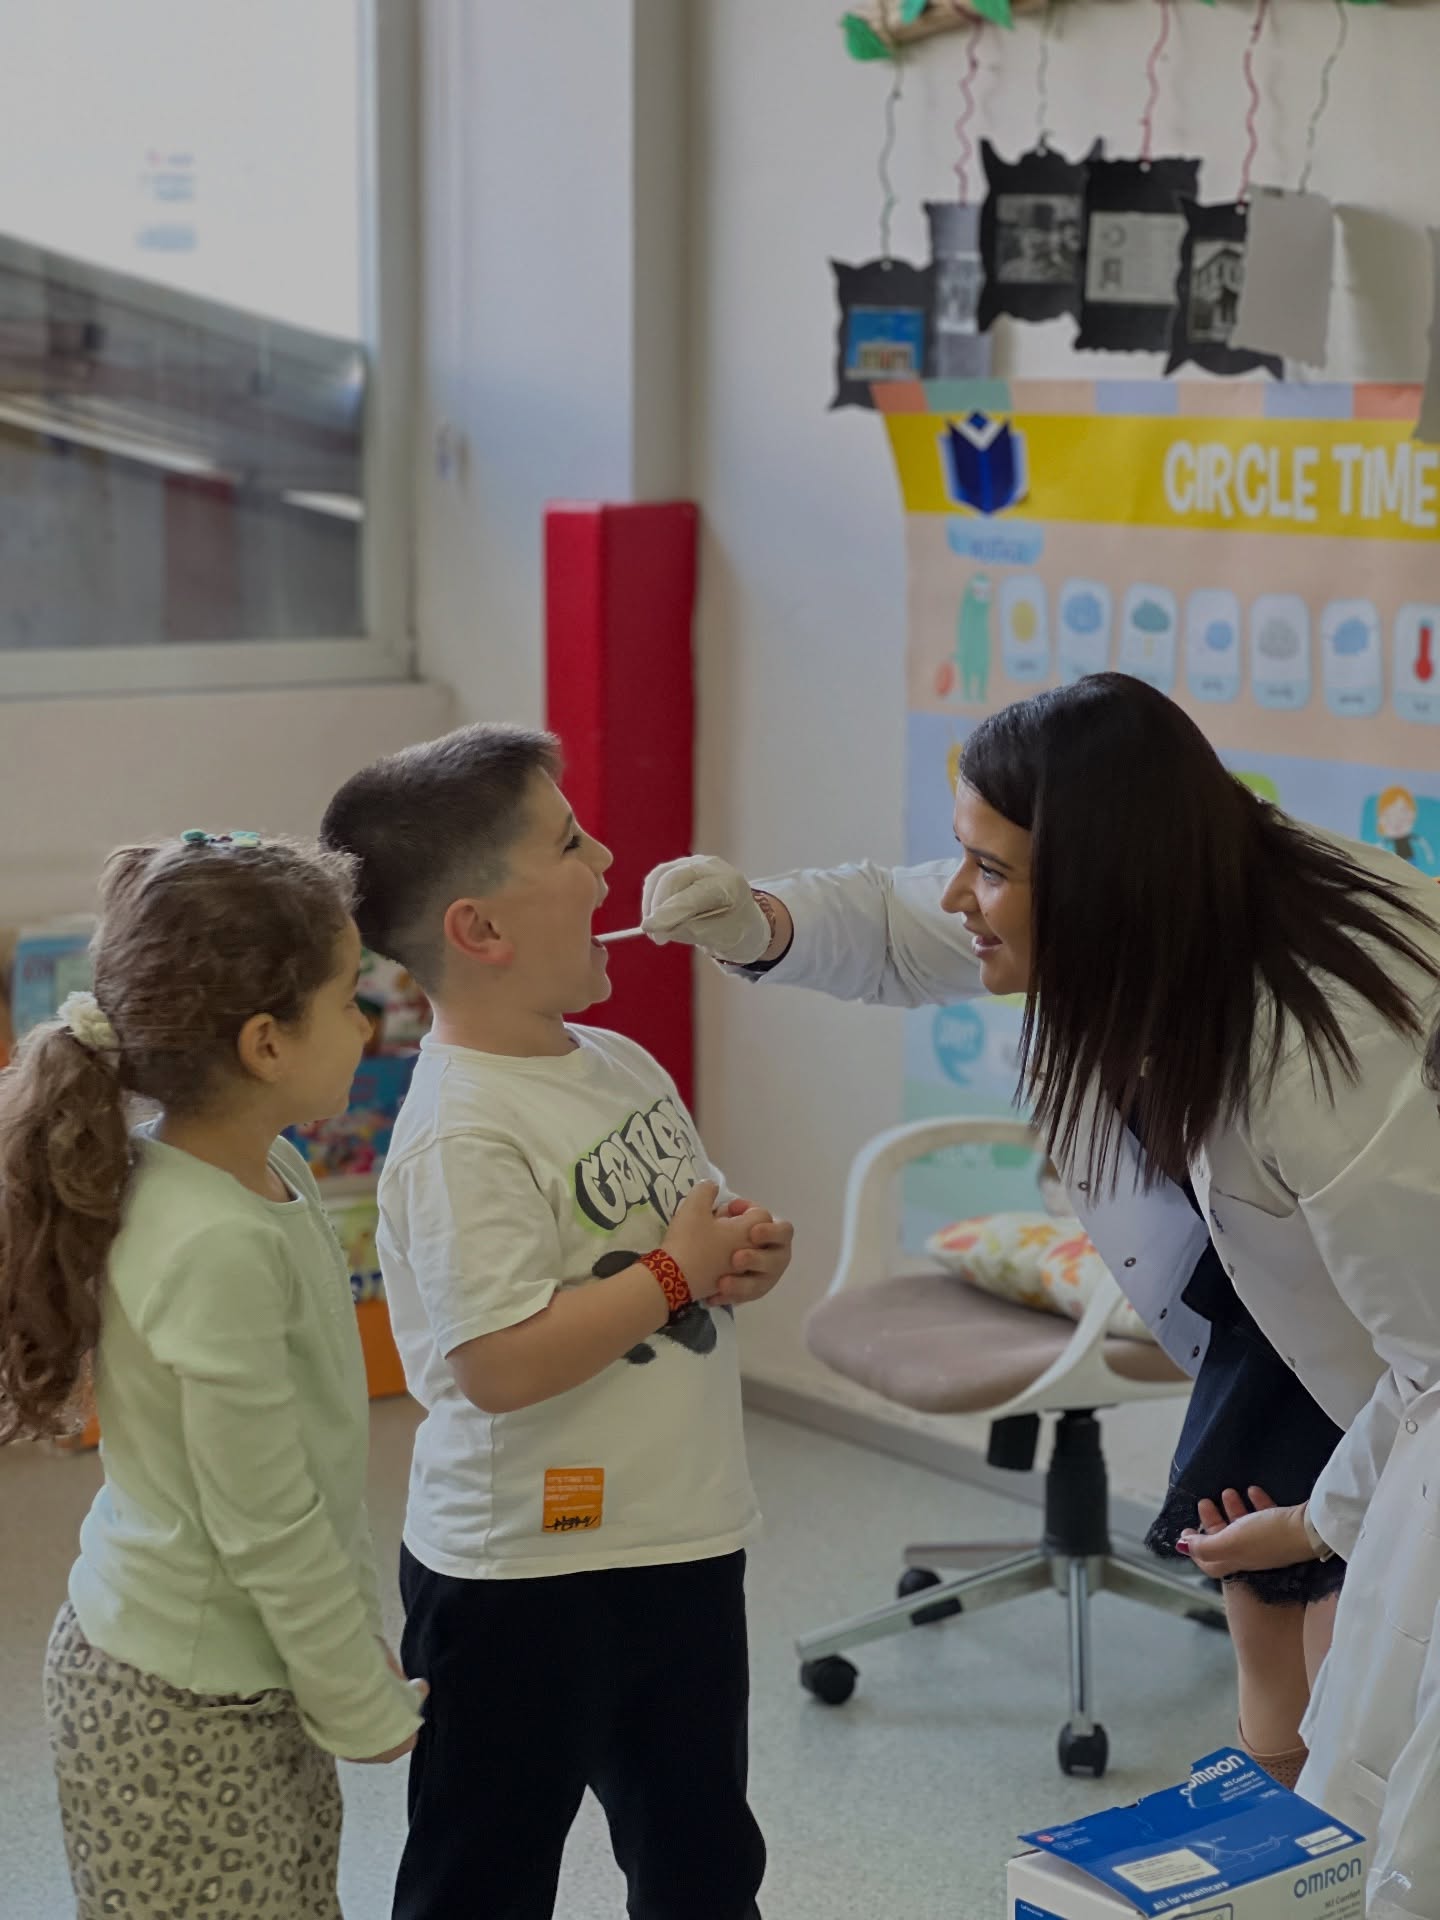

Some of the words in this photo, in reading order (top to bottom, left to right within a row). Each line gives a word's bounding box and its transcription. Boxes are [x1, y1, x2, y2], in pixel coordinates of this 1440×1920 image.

[1163, 439, 1320, 523] CIRCLE
[1331, 441, 1440, 528] TIME
[1179, 1881, 1230, 1901] Healthcare
[1293, 1857, 1361, 1898] OMRON
